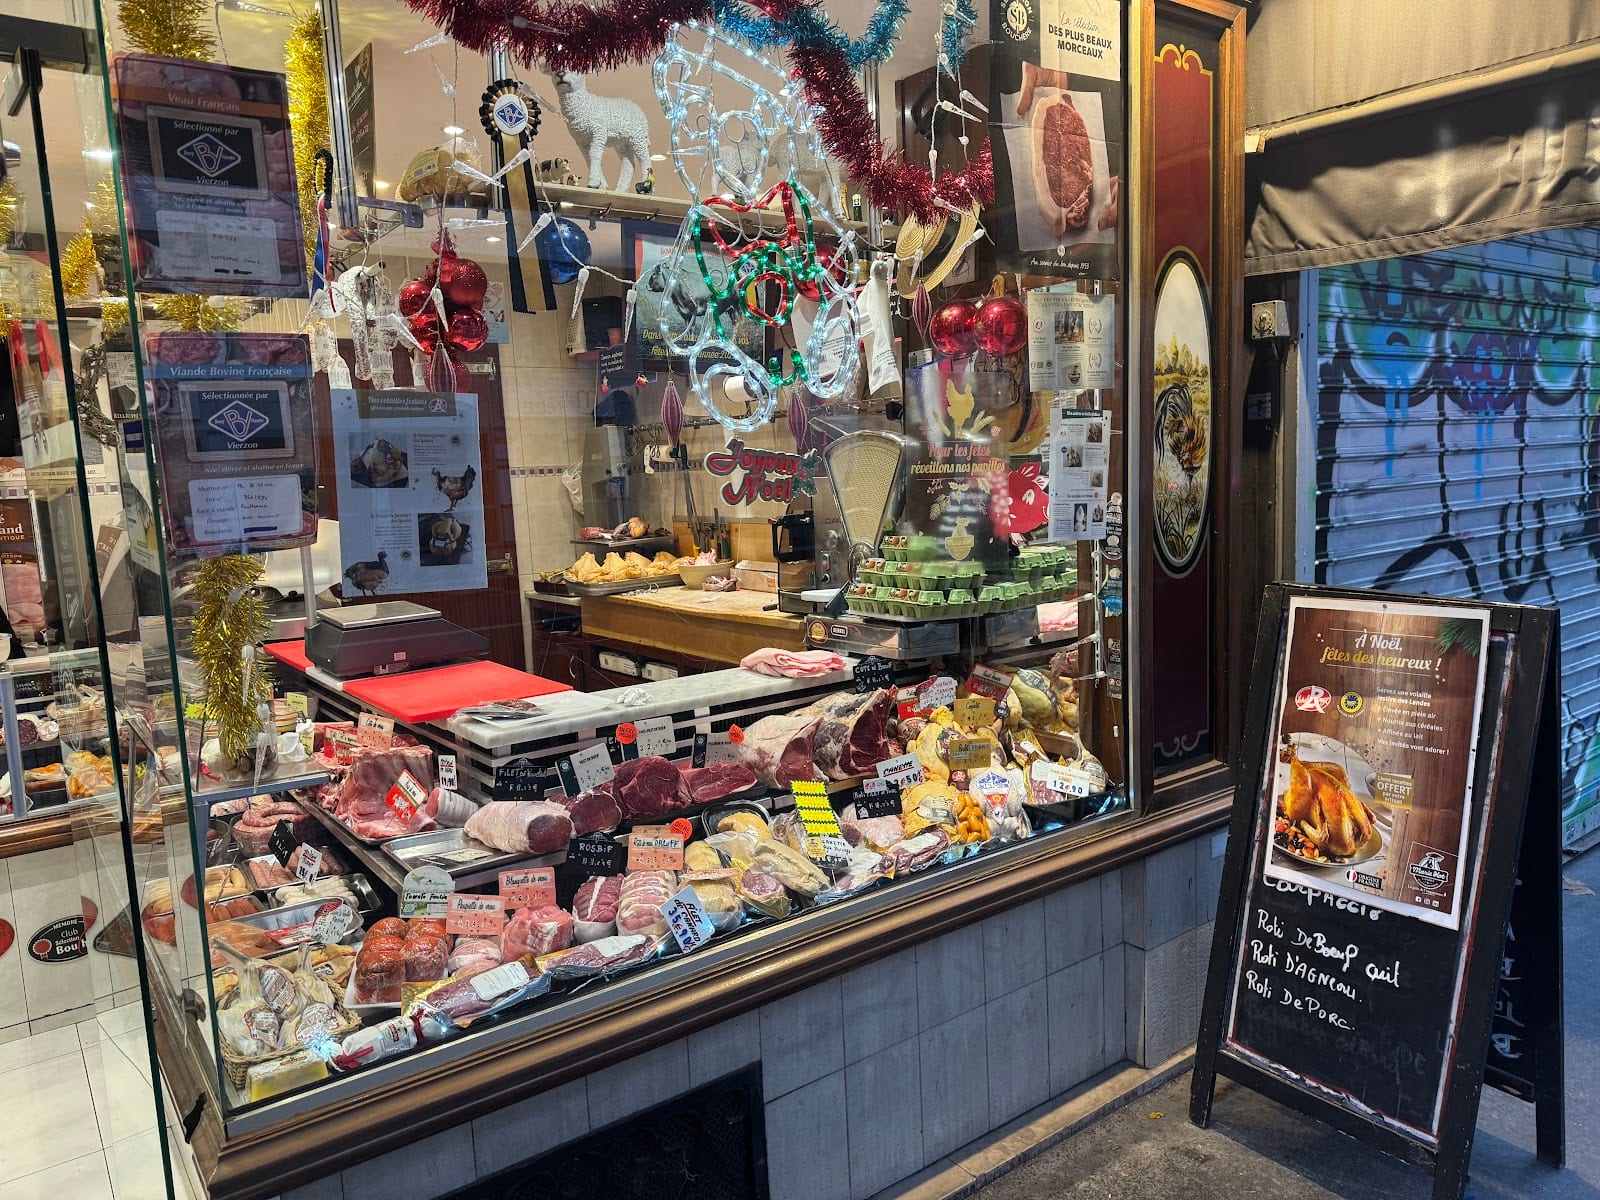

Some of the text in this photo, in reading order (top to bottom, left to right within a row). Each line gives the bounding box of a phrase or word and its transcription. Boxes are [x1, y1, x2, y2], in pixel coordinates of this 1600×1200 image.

[1048, 24, 1112, 50] DES PLUS BEAUX
[1057, 40, 1104, 60] MORCEAUX
[167, 93, 240, 112] Veau Français
[172, 120, 239, 136] Sélectionné par
[196, 176, 229, 186] Vierzon
[170, 366, 293, 378] Viande Bovine Française
[202, 391, 269, 402] Sélectionnée par
[227, 442, 258, 450] Vierzon
[927, 442, 992, 460] Pour les fêtes
[706, 438, 801, 477] Joyeux
[910, 459, 1006, 479] réveillons nos papilles
[723, 475, 792, 506] Noël
[1354, 629, 1403, 652] À Noël,
[1319, 646, 1443, 672] fêtes des heureux !
[1376, 686, 1396, 695] Servez
[1409, 690, 1432, 699] volaille
[1377, 694, 1431, 707] festive des Landes
[1411, 709, 1426, 718] plein
[1383, 717, 1404, 726] Nourrie
[1417, 722, 1444, 732] céréales
[1383, 728, 1404, 737] Affinée
[1413, 732, 1424, 740] lait
[1389, 740, 1409, 749] invités
[1410, 744, 1424, 752] vont
[1425, 746, 1446, 755] adorer
[1377, 781, 1412, 796] OFFERT
[1358, 873, 1380, 884] ORIGINE
[1358, 878, 1379, 888] FRANCE
[53, 918, 78, 930] MEMBRE
[60, 927, 79, 939] Club
